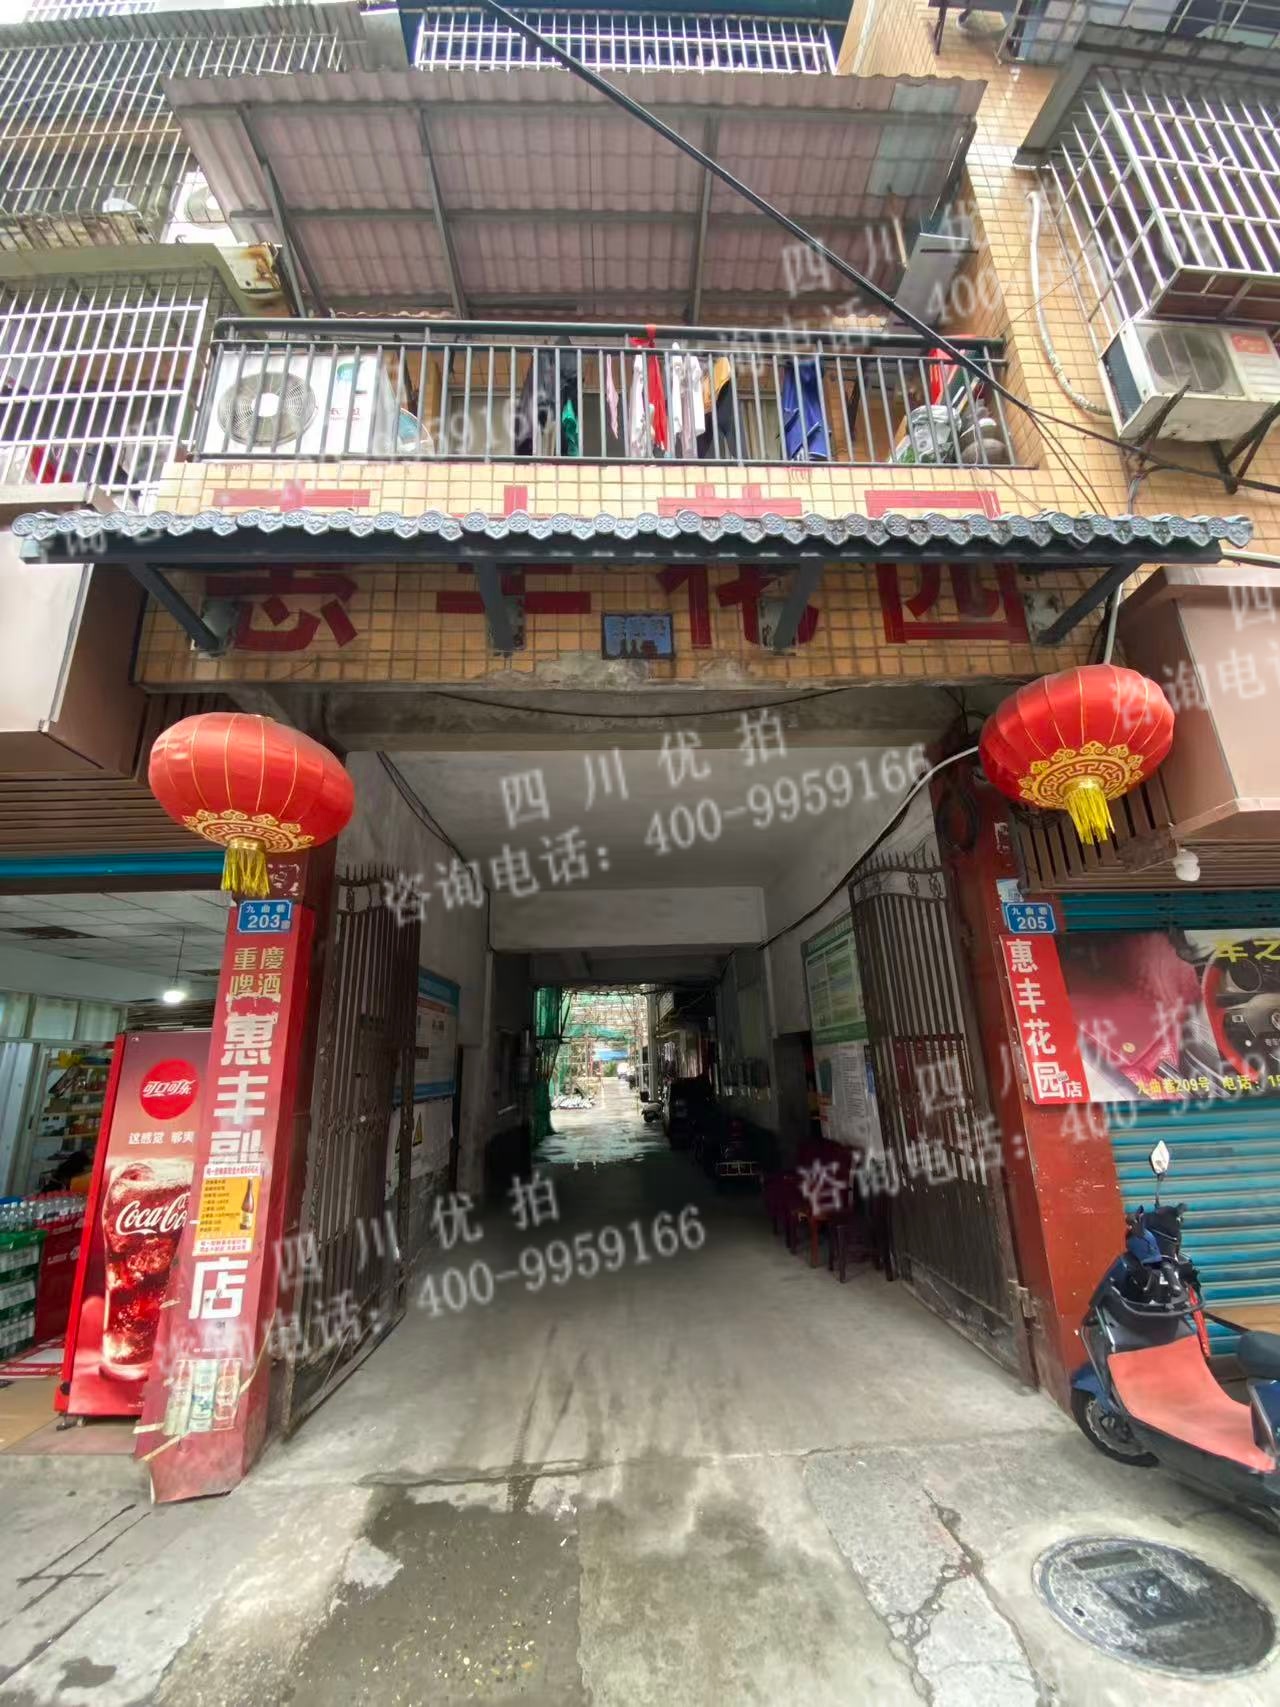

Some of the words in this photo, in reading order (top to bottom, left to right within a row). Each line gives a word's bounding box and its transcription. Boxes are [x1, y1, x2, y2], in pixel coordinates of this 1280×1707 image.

[247, 914, 280, 928] 203
[1017, 916, 1047, 930] 205
[1006, 938, 1066, 1099] 惠丰花园
[143, 1079, 196, 1098] 可口可乐
[1066, 1080, 1084, 1099] 店
[188, 1013, 278, 1320] 惠丰副店
[116, 1192, 191, 1237] Coca-Co
